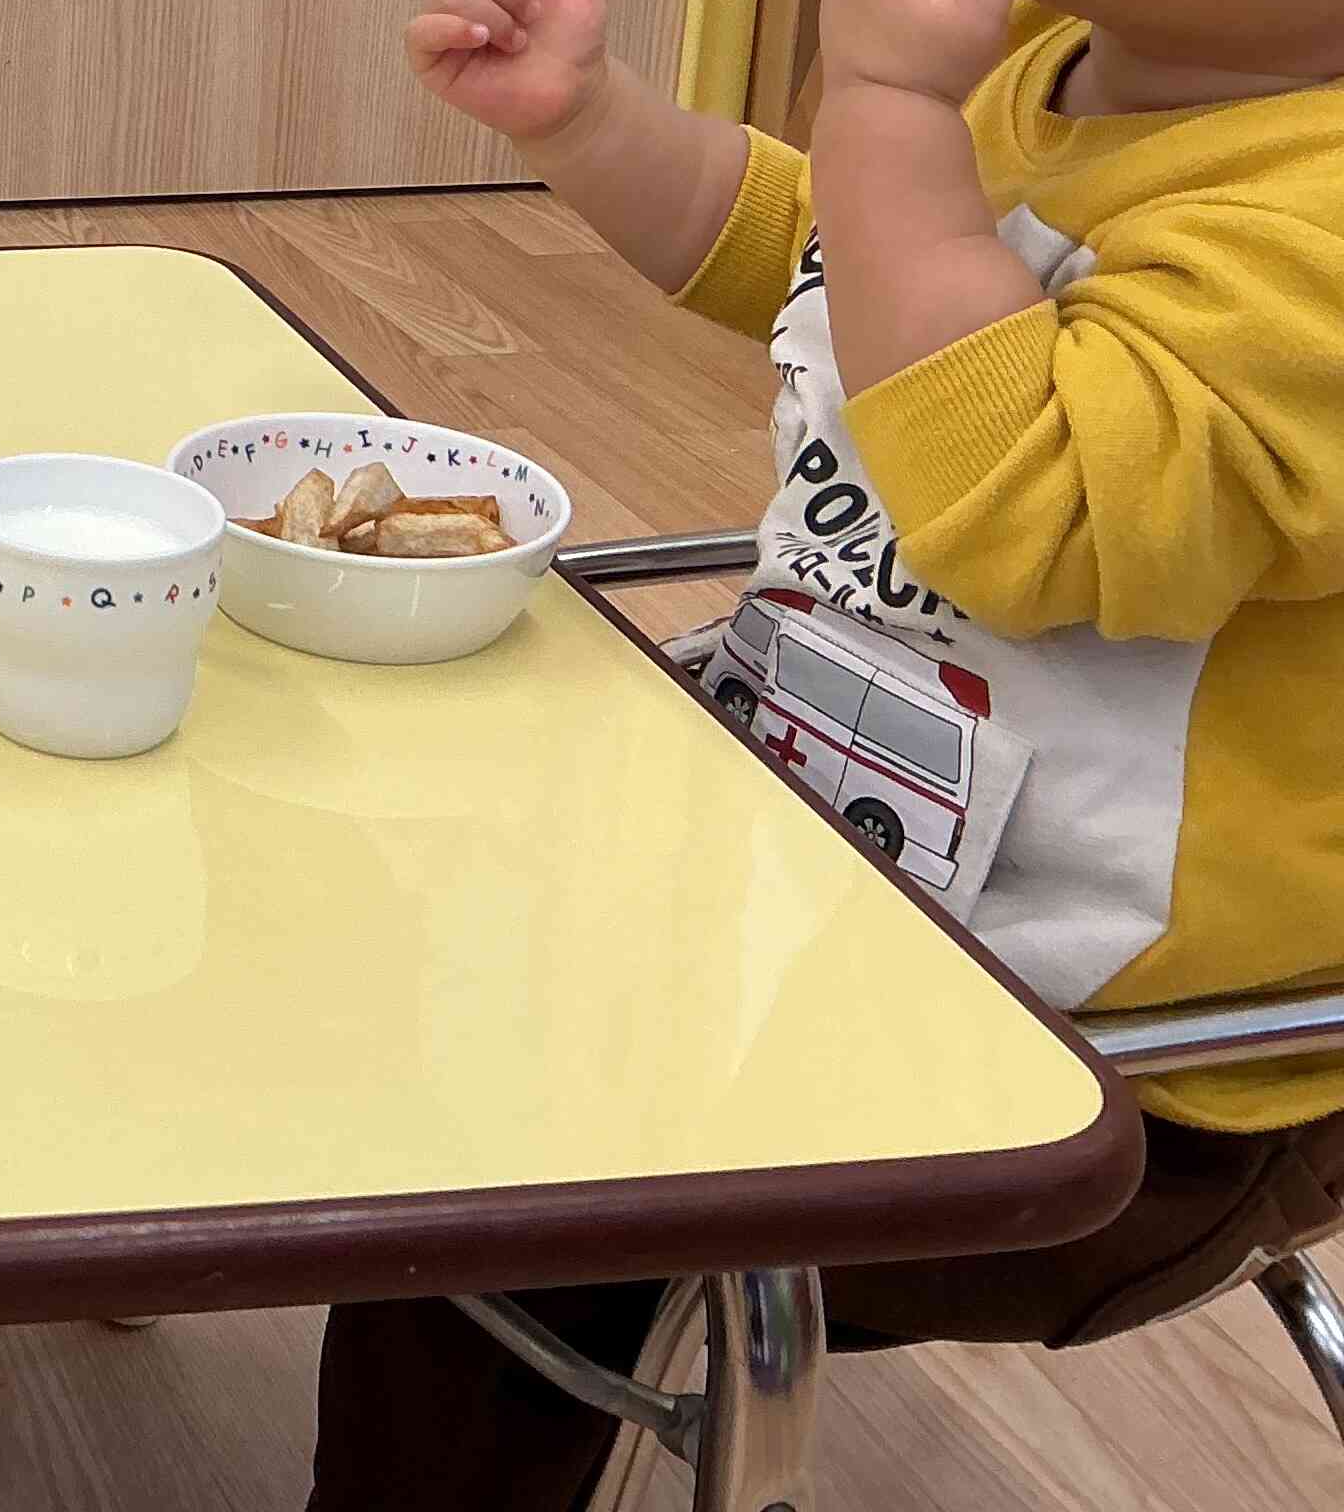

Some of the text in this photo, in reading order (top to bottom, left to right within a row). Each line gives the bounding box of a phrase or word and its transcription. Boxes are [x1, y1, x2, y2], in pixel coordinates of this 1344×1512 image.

[217, 440, 228, 458] E
[245, 443, 256, 463] F
[274, 430, 289, 449] G
[314, 437, 333, 458] H
[402, 436, 418, 454] J
[448, 449, 462, 466] K
[22, 586, 35, 602] P
[90, 588, 116, 609] Q
[165, 583, 180, 604] R
